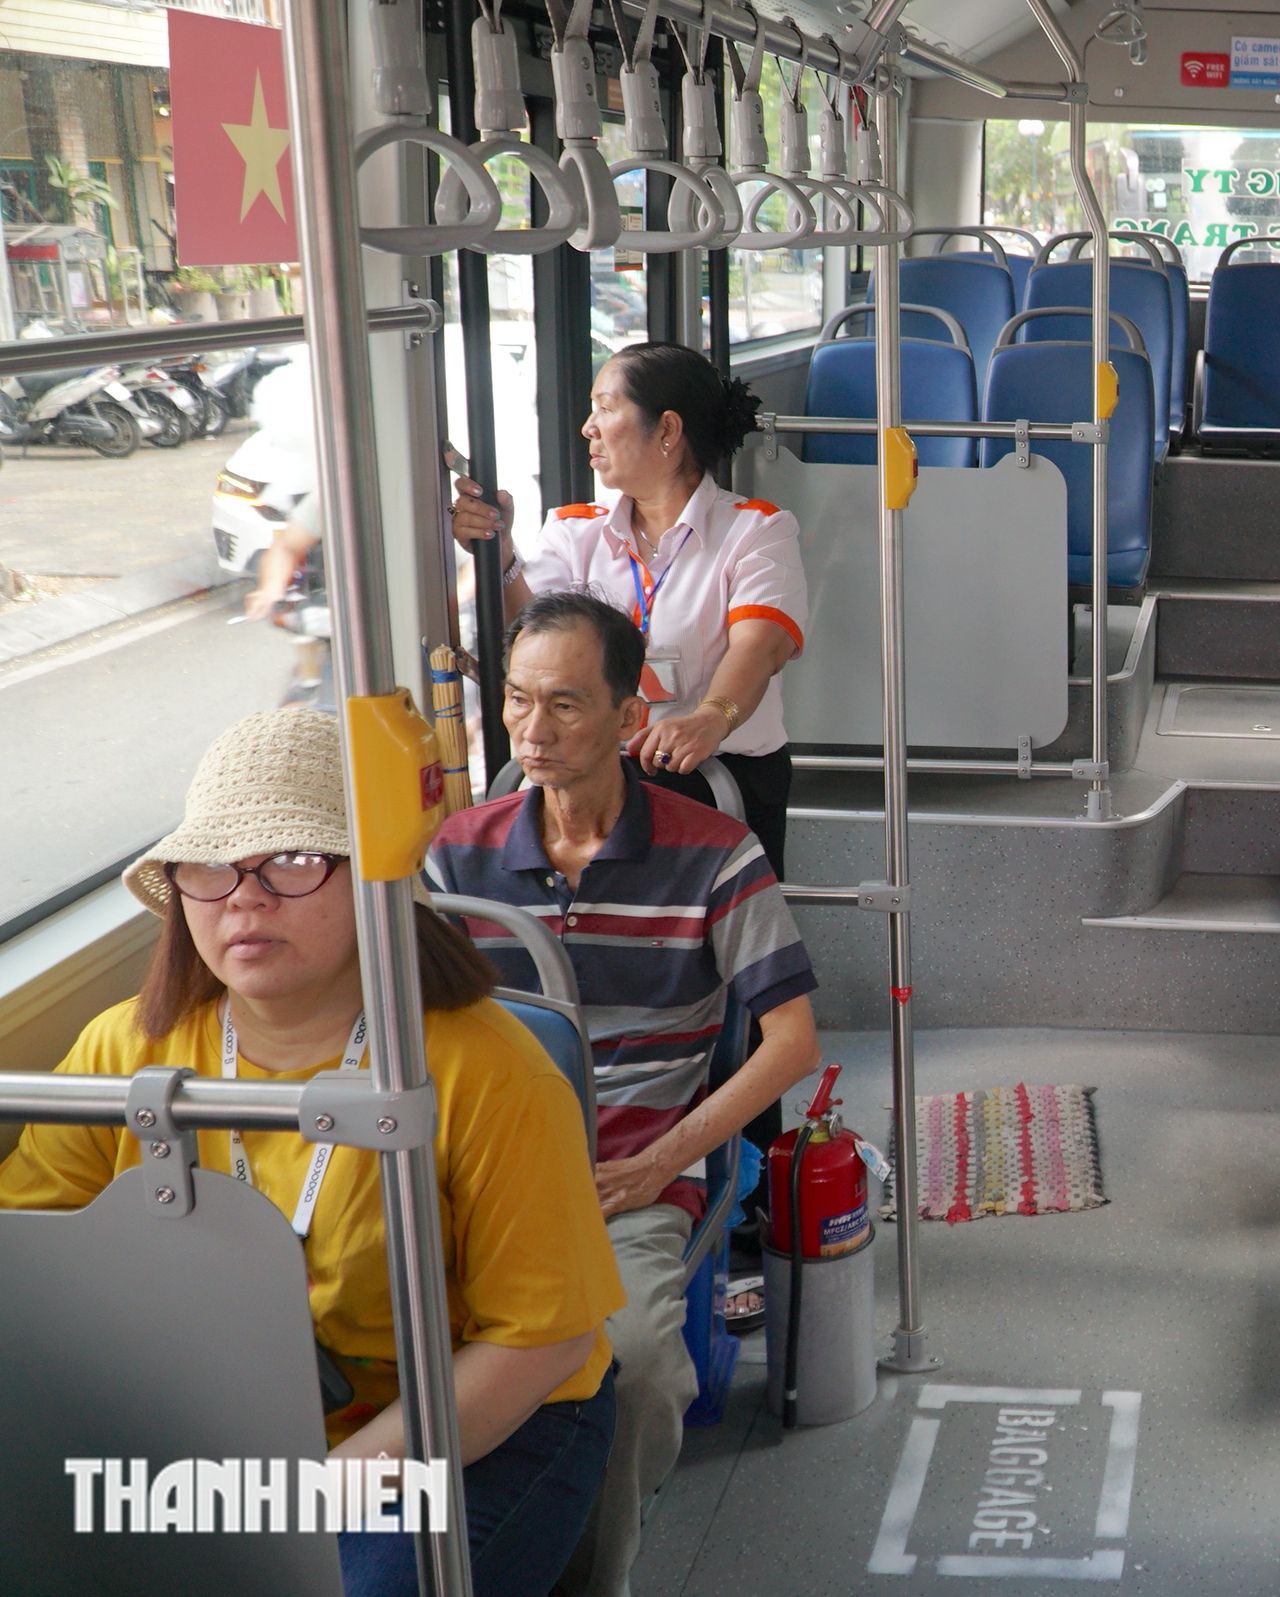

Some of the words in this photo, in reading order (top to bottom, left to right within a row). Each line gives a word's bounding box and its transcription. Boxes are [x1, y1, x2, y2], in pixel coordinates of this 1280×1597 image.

[1234, 40, 1247, 51] Có
[1234, 54, 1259, 67] giám
[1263, 56, 1279, 66] sát
[1206, 63, 1225, 72] FREE
[1206, 71, 1223, 79] WIFI
[968, 1408, 1056, 1550] BAGGAGE
